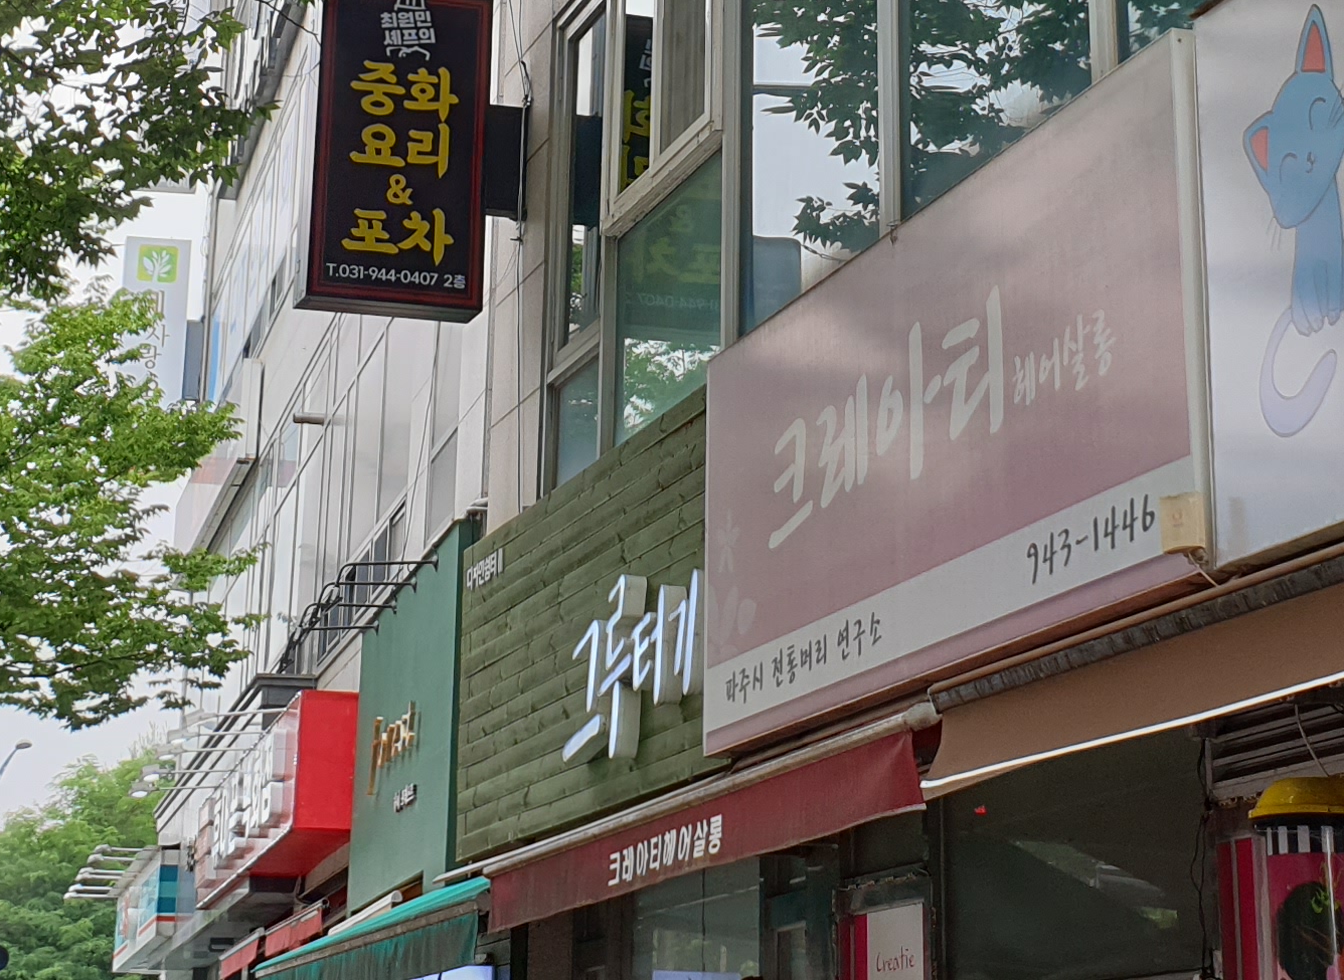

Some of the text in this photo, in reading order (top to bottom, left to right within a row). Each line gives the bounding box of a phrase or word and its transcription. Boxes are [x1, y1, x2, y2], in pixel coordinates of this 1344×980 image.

[349, 59, 460, 123] 중화
[349, 122, 451, 179] 요리
[386, 173, 414, 206] &
[341, 207, 455, 267] 포차
[325, 262, 439, 287] T.031-944-0407
[768, 284, 1116, 550] 크레아티 헤어살롱
[1026, 493, 1155, 586] 943-1446
[561, 568, 699, 763] 그루터기
[725, 611, 883, 705] 파주시 전통머리 연구소
[607, 813, 723, 887] 크레아티헤어살롱
